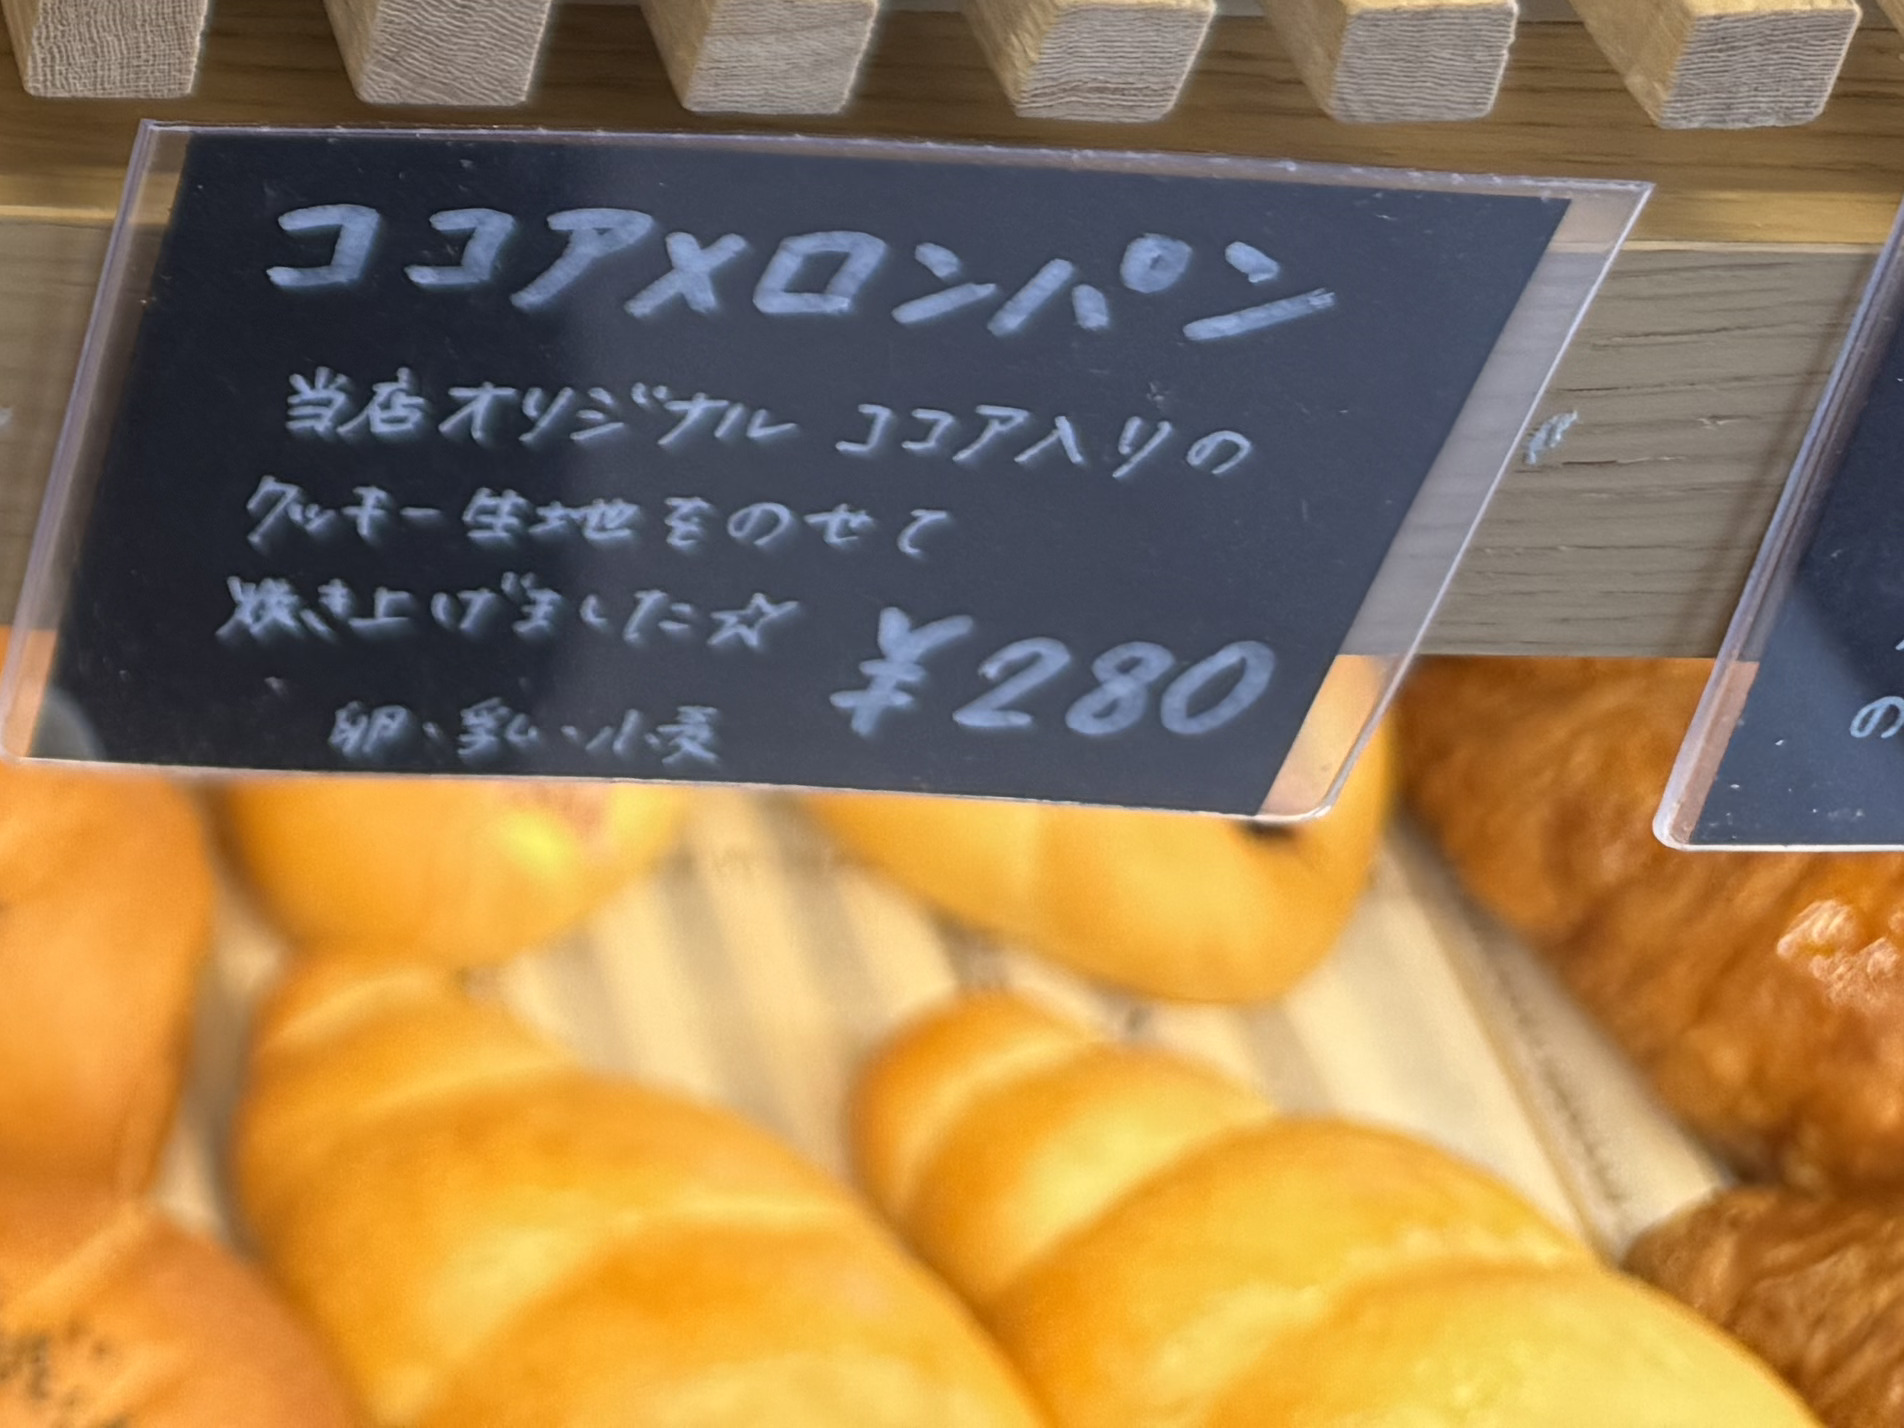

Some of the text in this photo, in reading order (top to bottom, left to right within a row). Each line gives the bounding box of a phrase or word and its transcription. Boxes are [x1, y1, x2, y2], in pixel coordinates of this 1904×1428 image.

[265, 202, 1337, 343] ココアメロンパン
[287, 365, 1255, 480] 当店オリジナル ココア入りの
[829, 605, 1277, 737] ¥280
